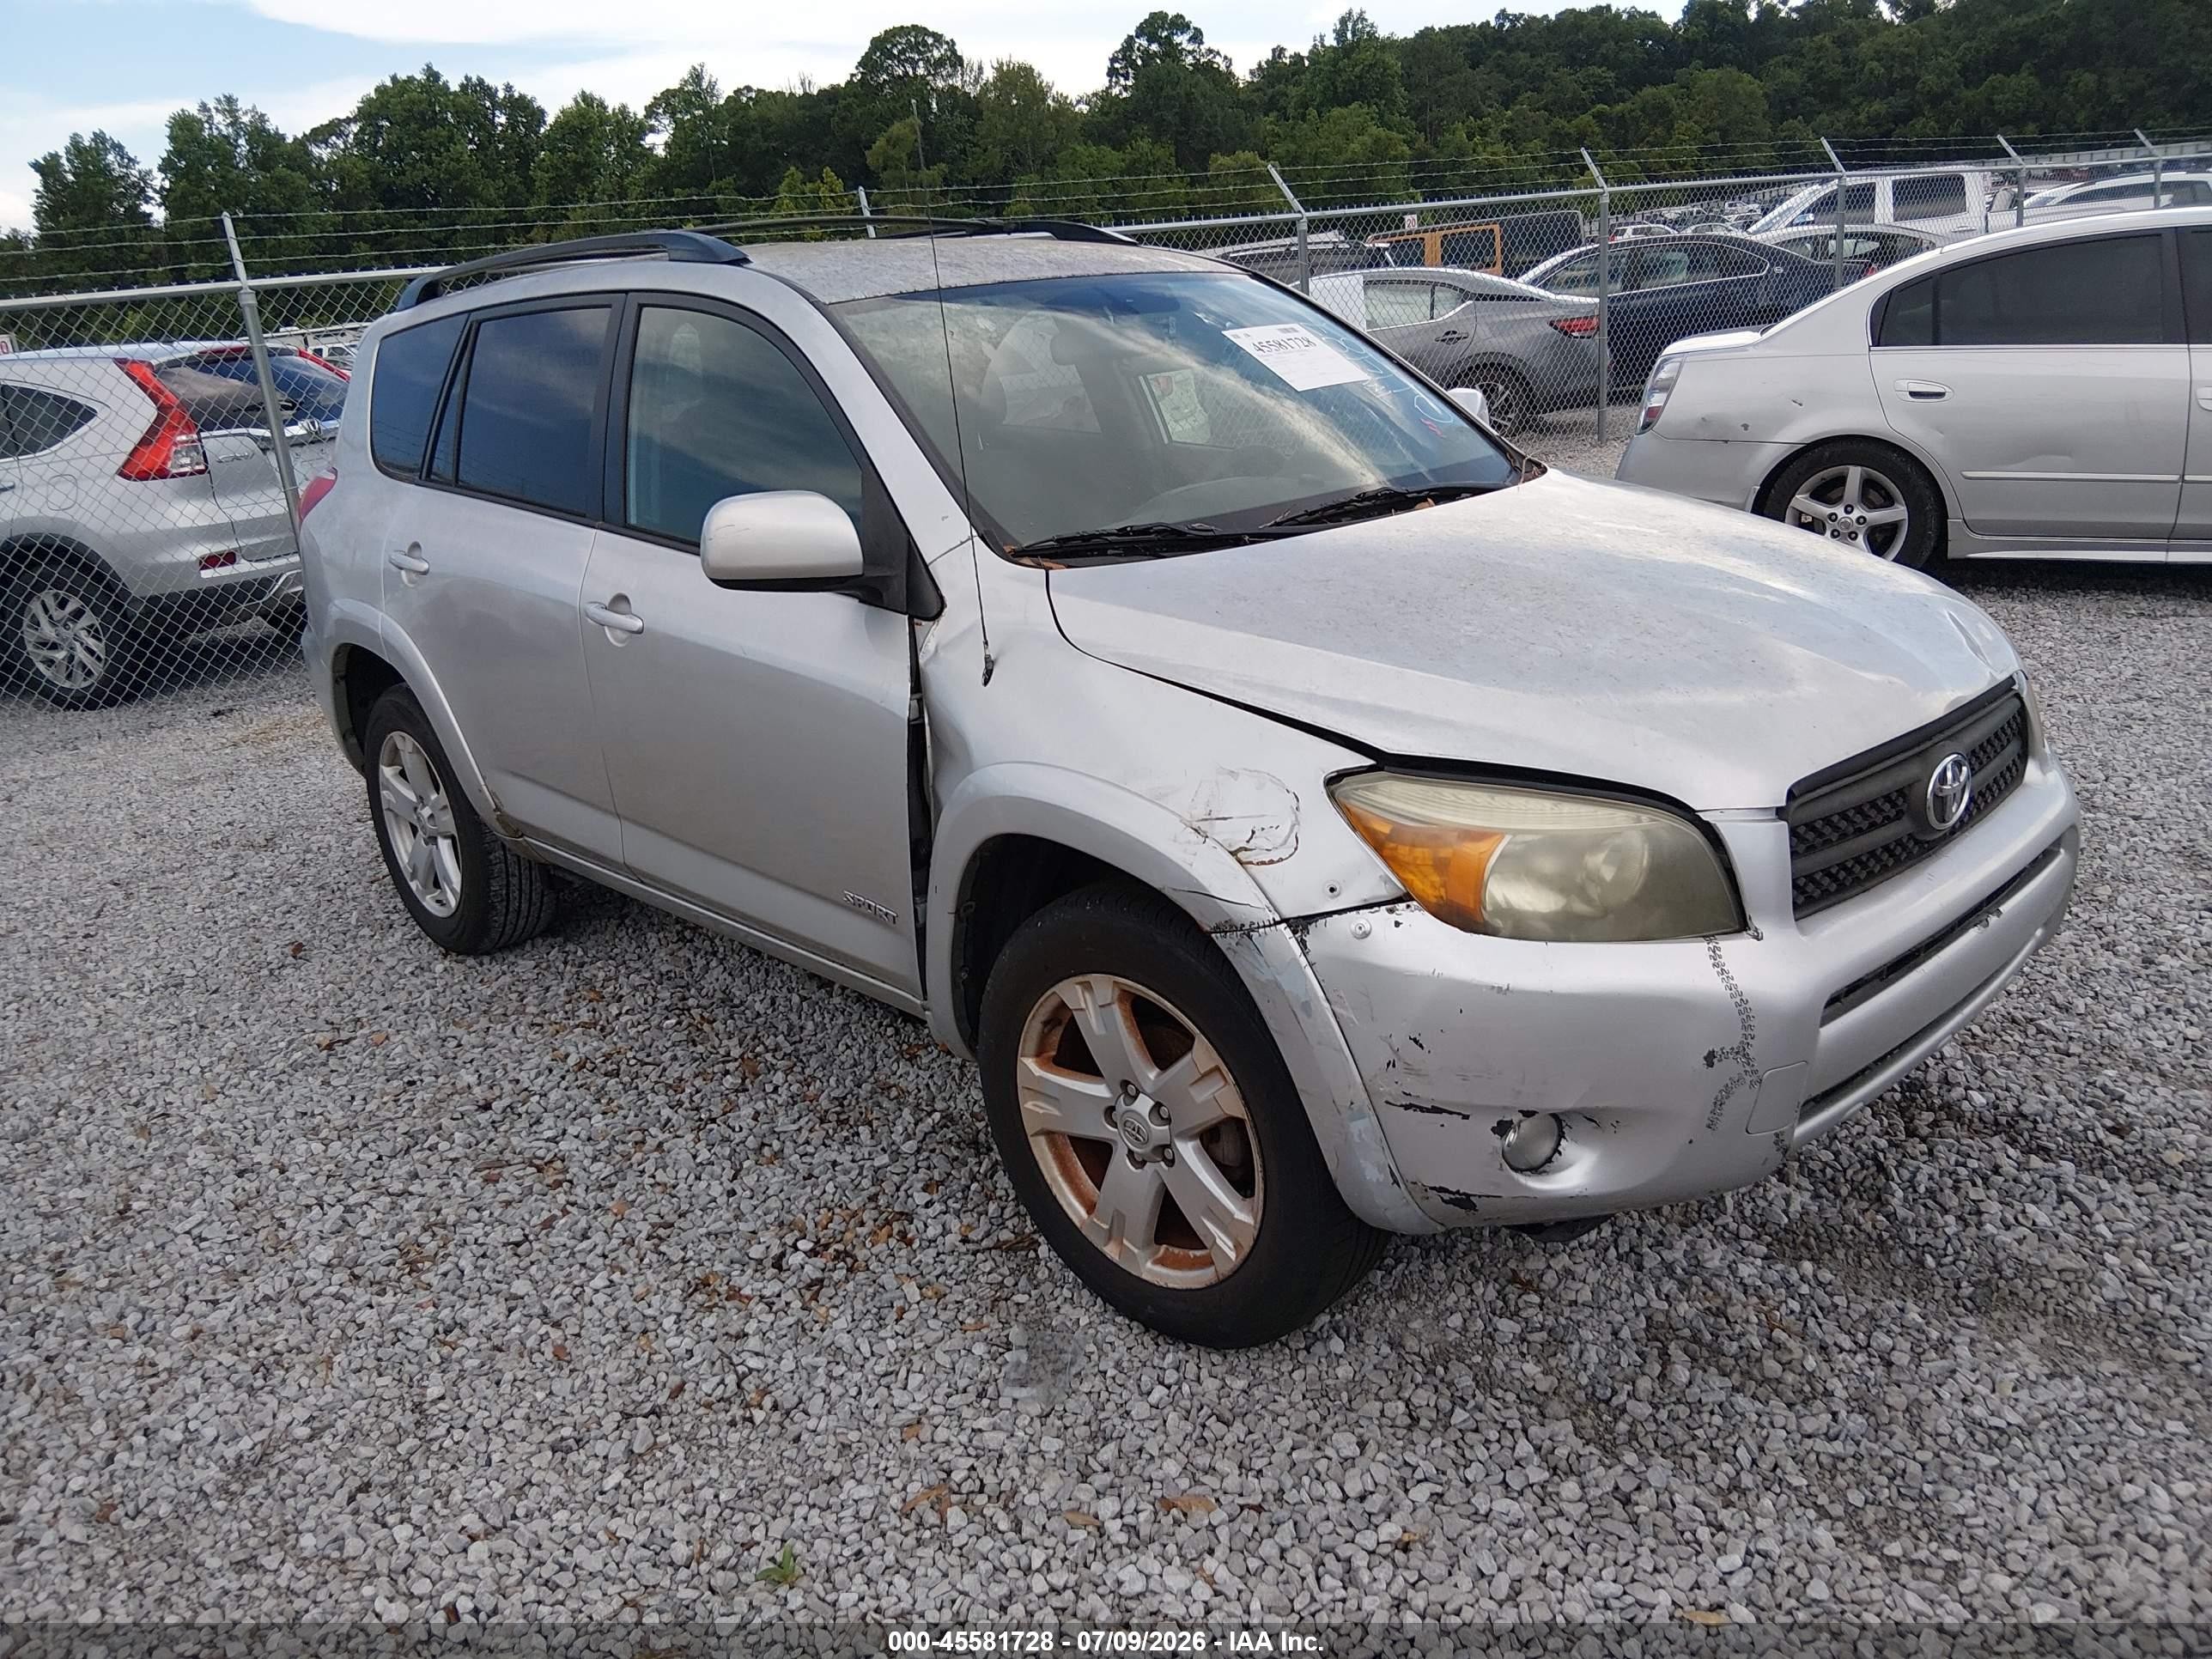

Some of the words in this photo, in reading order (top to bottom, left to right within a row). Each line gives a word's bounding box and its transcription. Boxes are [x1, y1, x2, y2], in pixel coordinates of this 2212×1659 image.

[1407, 218, 1416, 228] 20
[1251, 336, 1317, 354] 45581728
[842, 889, 899, 925] SPORT
